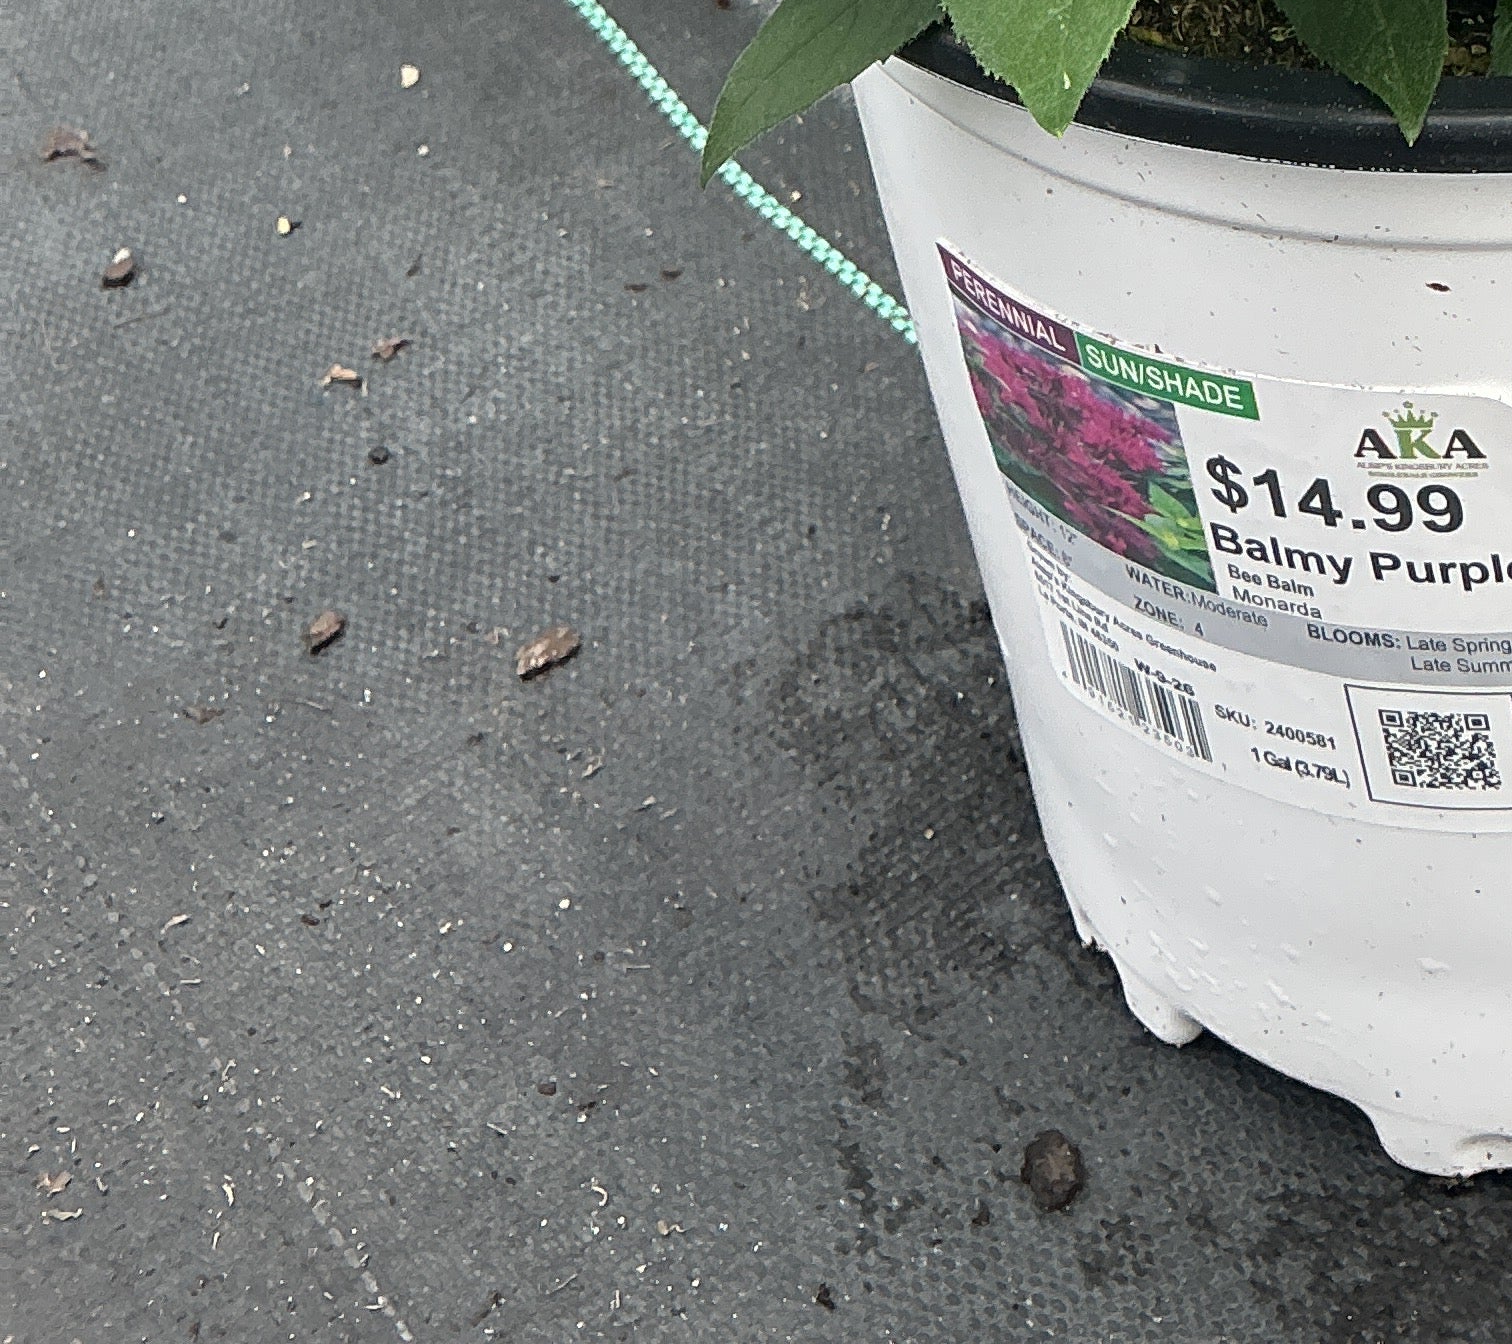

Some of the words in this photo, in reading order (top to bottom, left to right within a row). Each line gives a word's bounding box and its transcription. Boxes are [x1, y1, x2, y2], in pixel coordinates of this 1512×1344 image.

[950, 258, 1066, 352] PERENNIAL
[1085, 343, 1244, 410] SUN/SHADE
[1354, 428, 1487, 459] AKA
[1206, 454, 1464, 533] $14.99
[1209, 522, 1353, 585] Balmy
[1227, 563, 1262, 586] Bee
[1266, 573, 1315, 597] Balm
[1133, 594, 1184, 630] ZONE:
[1194, 623, 1205, 637] 4
[1232, 586, 1323, 620] Monarda
[1145, 634, 1217, 672] Greenhouse
[1307, 623, 1401, 650] BLOOMS:
[1407, 635, 1447, 652] Late
[1453, 637, 1512, 656] Spring
[1411, 656, 1451, 673] Late
[1214, 704, 1257, 730] SKU:
[1265, 720, 1336, 750] 2400581
[1250, 746, 1260, 762] 1
[1263, 750, 1291, 771] Gal
